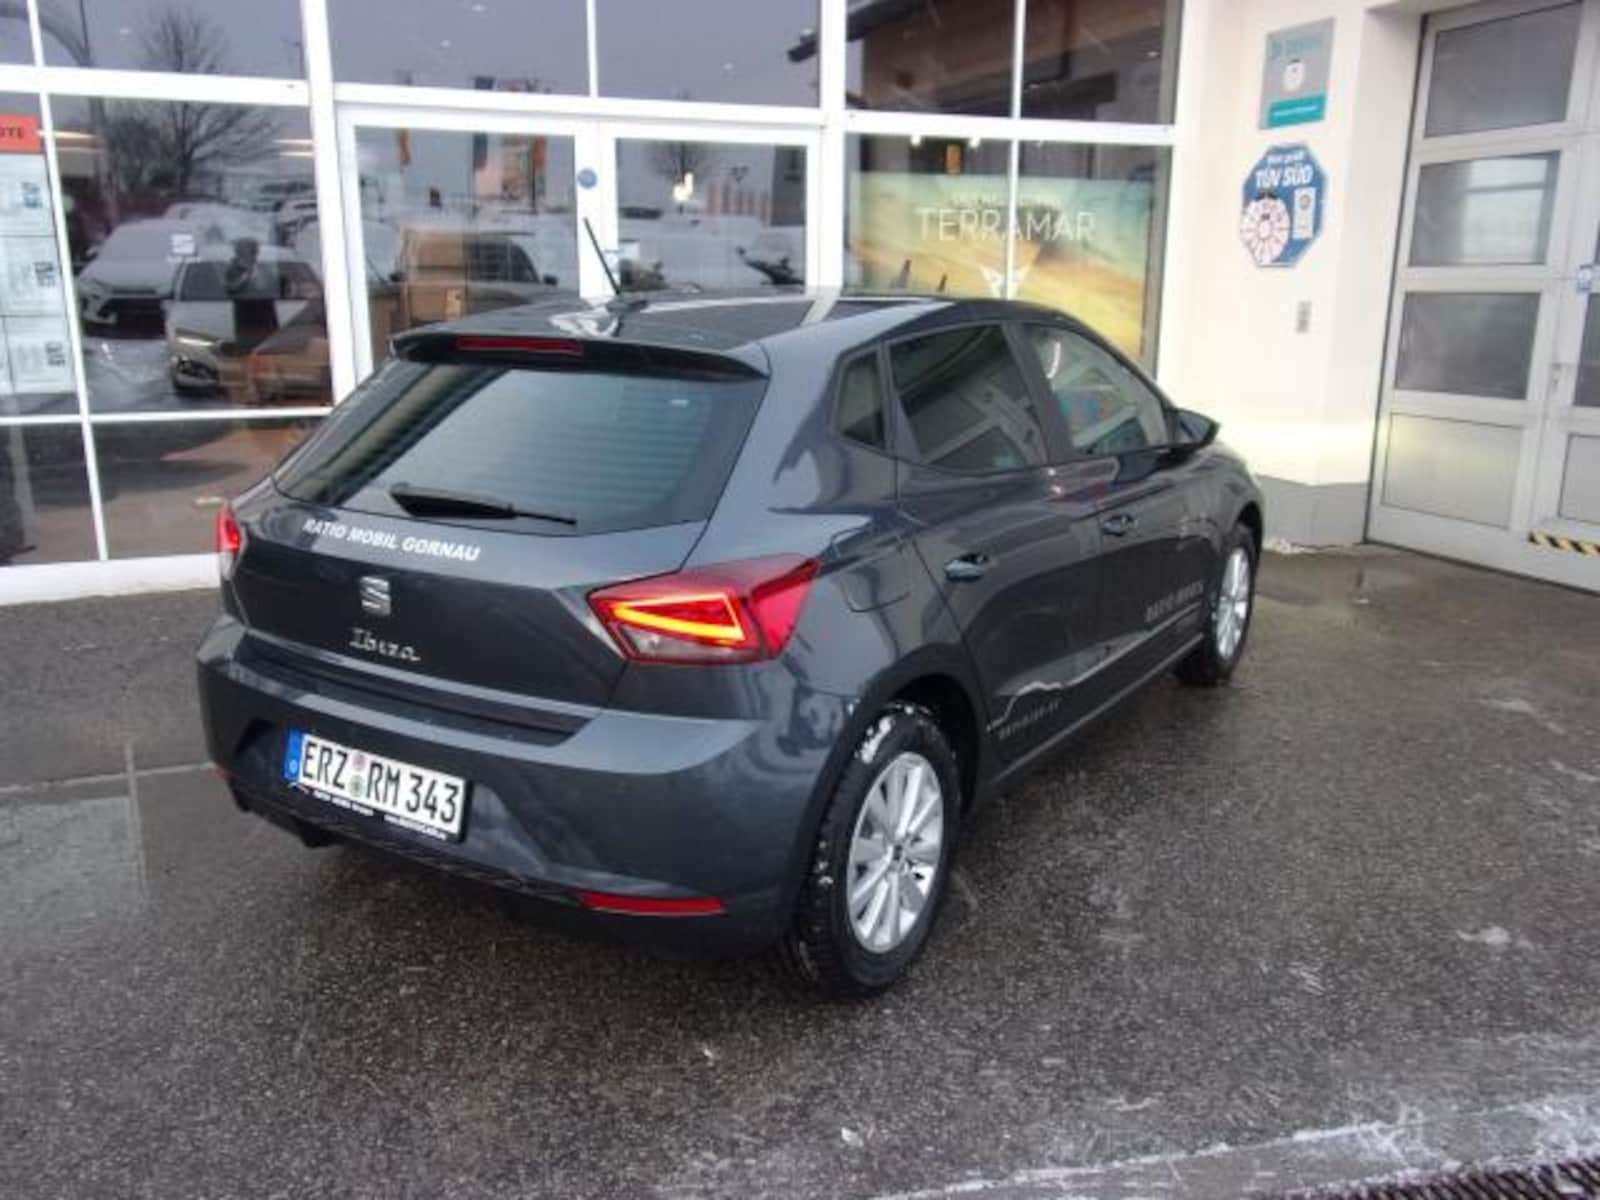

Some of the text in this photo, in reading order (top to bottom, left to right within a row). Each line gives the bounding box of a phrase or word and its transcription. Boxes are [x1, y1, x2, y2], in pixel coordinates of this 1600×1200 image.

[915, 207, 1097, 242] TERRAMAR
[302, 519, 481, 562] RATIO MOBIL GORNAU
[349, 626, 422, 662] Ibiza
[302, 741, 348, 790] ERZ
[366, 762, 401, 808] RM
[405, 772, 460, 824] 343
